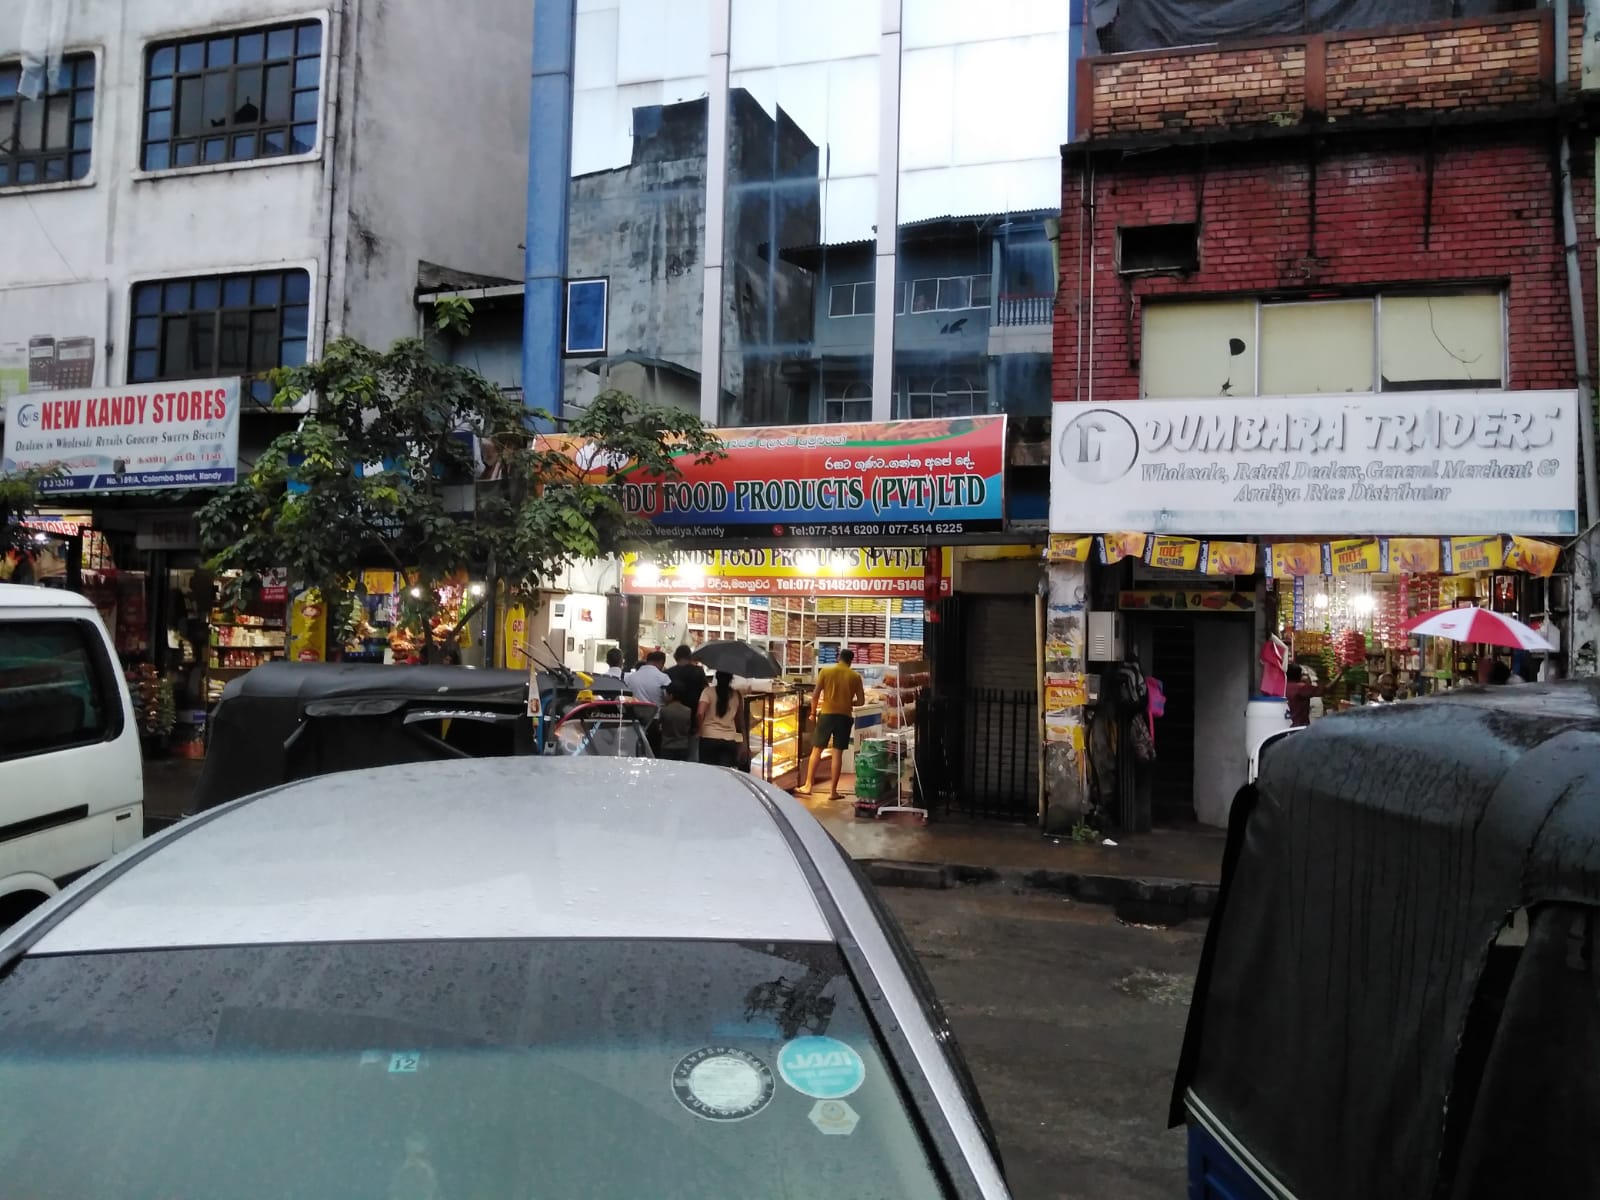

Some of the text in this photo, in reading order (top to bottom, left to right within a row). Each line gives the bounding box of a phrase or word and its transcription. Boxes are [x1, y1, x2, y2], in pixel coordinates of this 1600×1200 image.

[41, 388, 226, 430] NEW KANDY STORES
[1144, 411, 1347, 454] DUMBARA
[142, 474, 175, 483] Colombo
[199, 472, 222, 481] Kandy
[1141, 462, 1230, 484] Wholesale,
[1233, 461, 1291, 481] Retail
[1441, 459, 1533, 479] Merchant
[1536, 458, 1560, 478] &
[662, 481, 729, 514] FOOD
[733, 475, 865, 513] PRODUCTS
[871, 473, 986, 517] (PVT)LTD
[1233, 482, 1301, 506] Araliya
[1303, 482, 1345, 502] Rice
[853, 524, 879, 536] 6200
[888, 523, 932, 535] 077-514
[935, 523, 963, 534] 6225
[720, 548, 766, 567] FOOD
